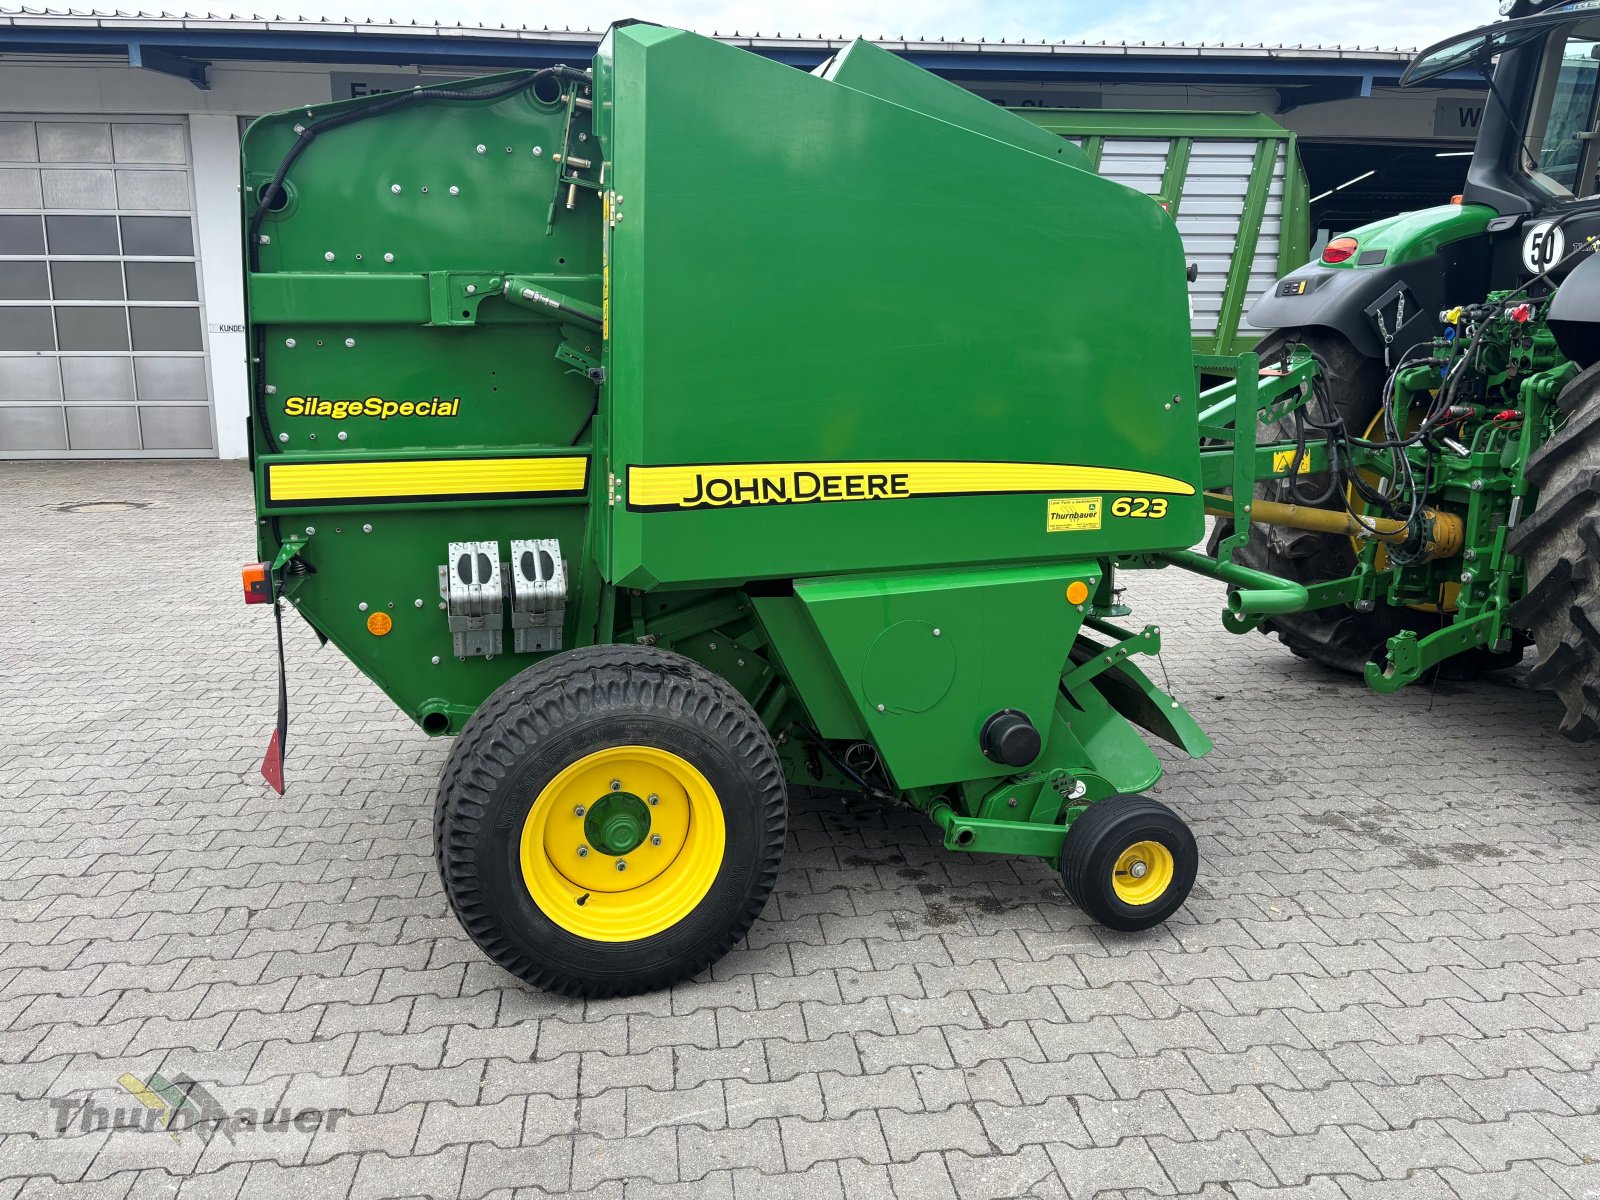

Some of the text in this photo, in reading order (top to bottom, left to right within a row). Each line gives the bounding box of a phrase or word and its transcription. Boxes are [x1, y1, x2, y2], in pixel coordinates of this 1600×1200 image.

[1531, 232, 1555, 266] 50
[283, 396, 459, 420] SilageSpecial
[683, 471, 910, 503] JOHN DEERE
[1050, 510, 1097, 521] Thurnbauer
[1111, 496, 1168, 519] 623
